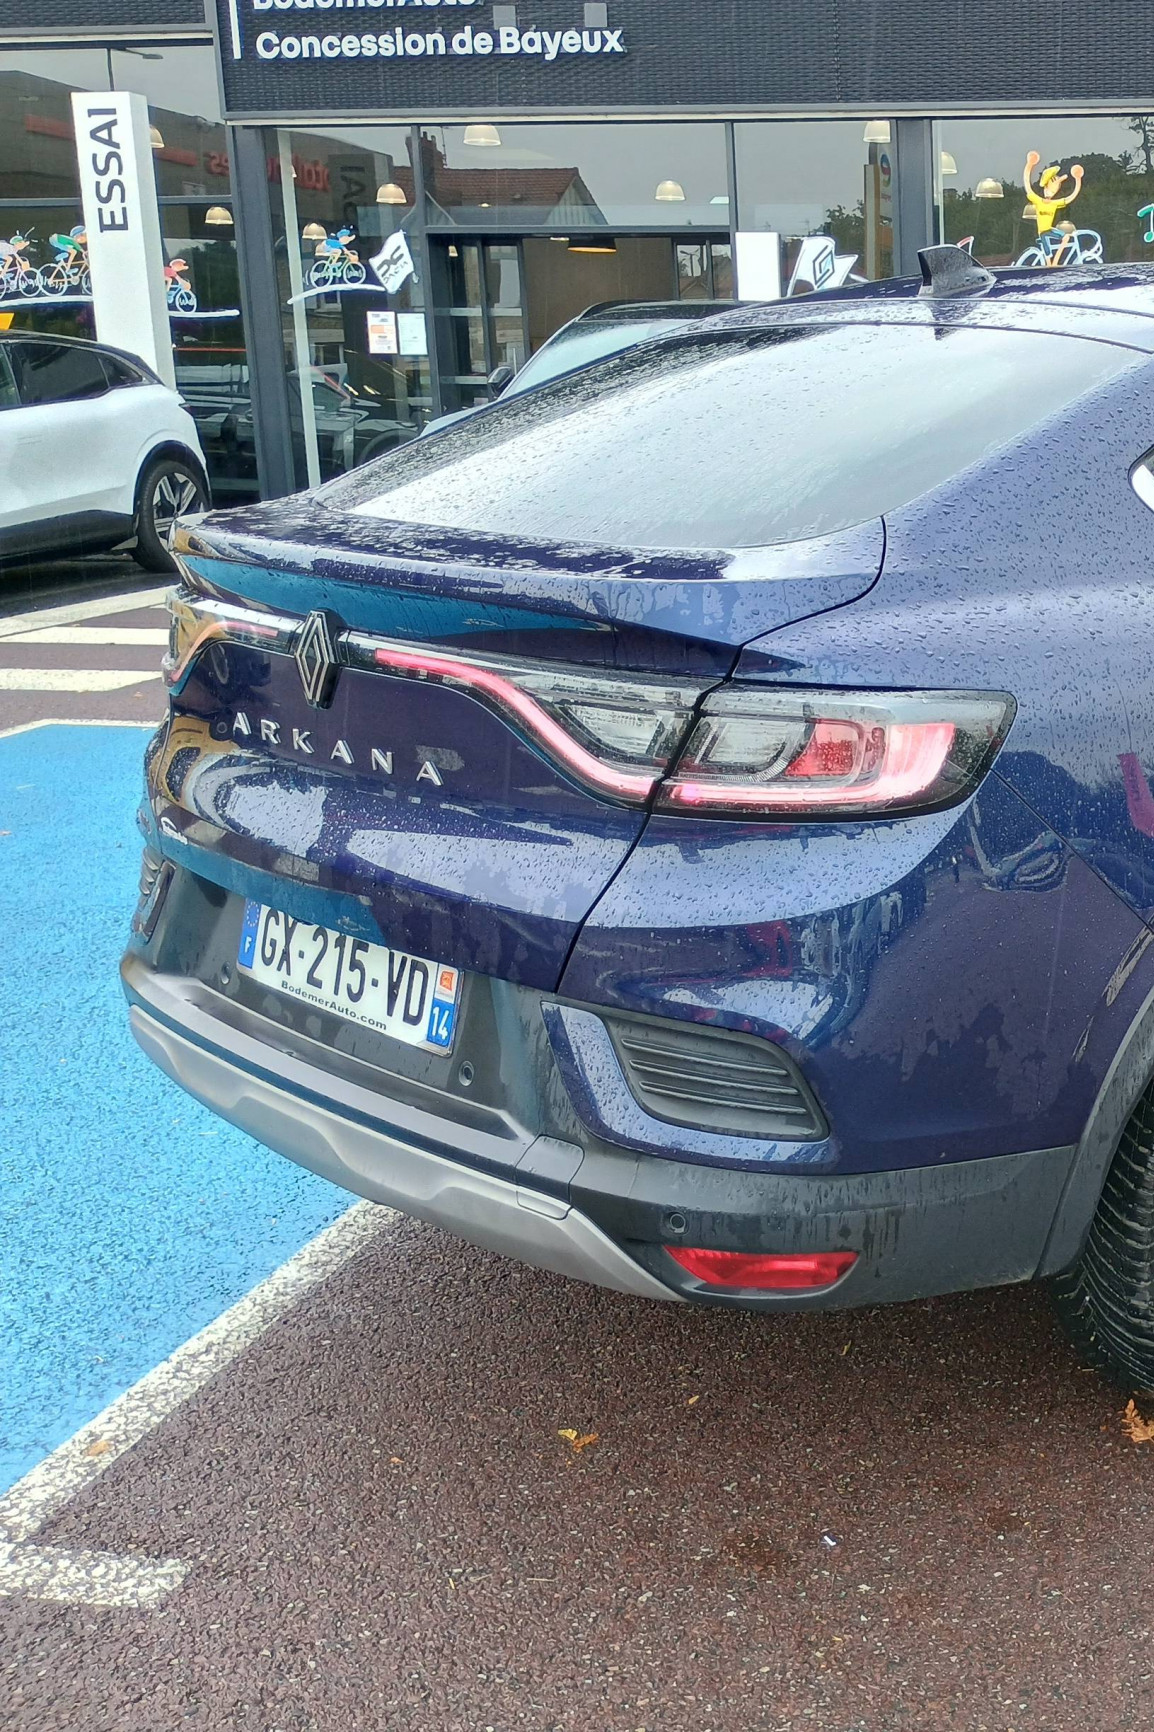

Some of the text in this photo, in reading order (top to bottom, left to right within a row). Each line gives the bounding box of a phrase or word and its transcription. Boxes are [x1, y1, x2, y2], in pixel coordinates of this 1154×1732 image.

[255, 26, 623, 61] Concession de Bayeux
[87, 107, 129, 233] ESSAI
[383, 260, 409, 285] DACIA
[232, 712, 444, 787] ARKANA
[243, 908, 450, 1040] F GX-215-VD 14
[281, 979, 388, 1031] BodemerAuto.com
